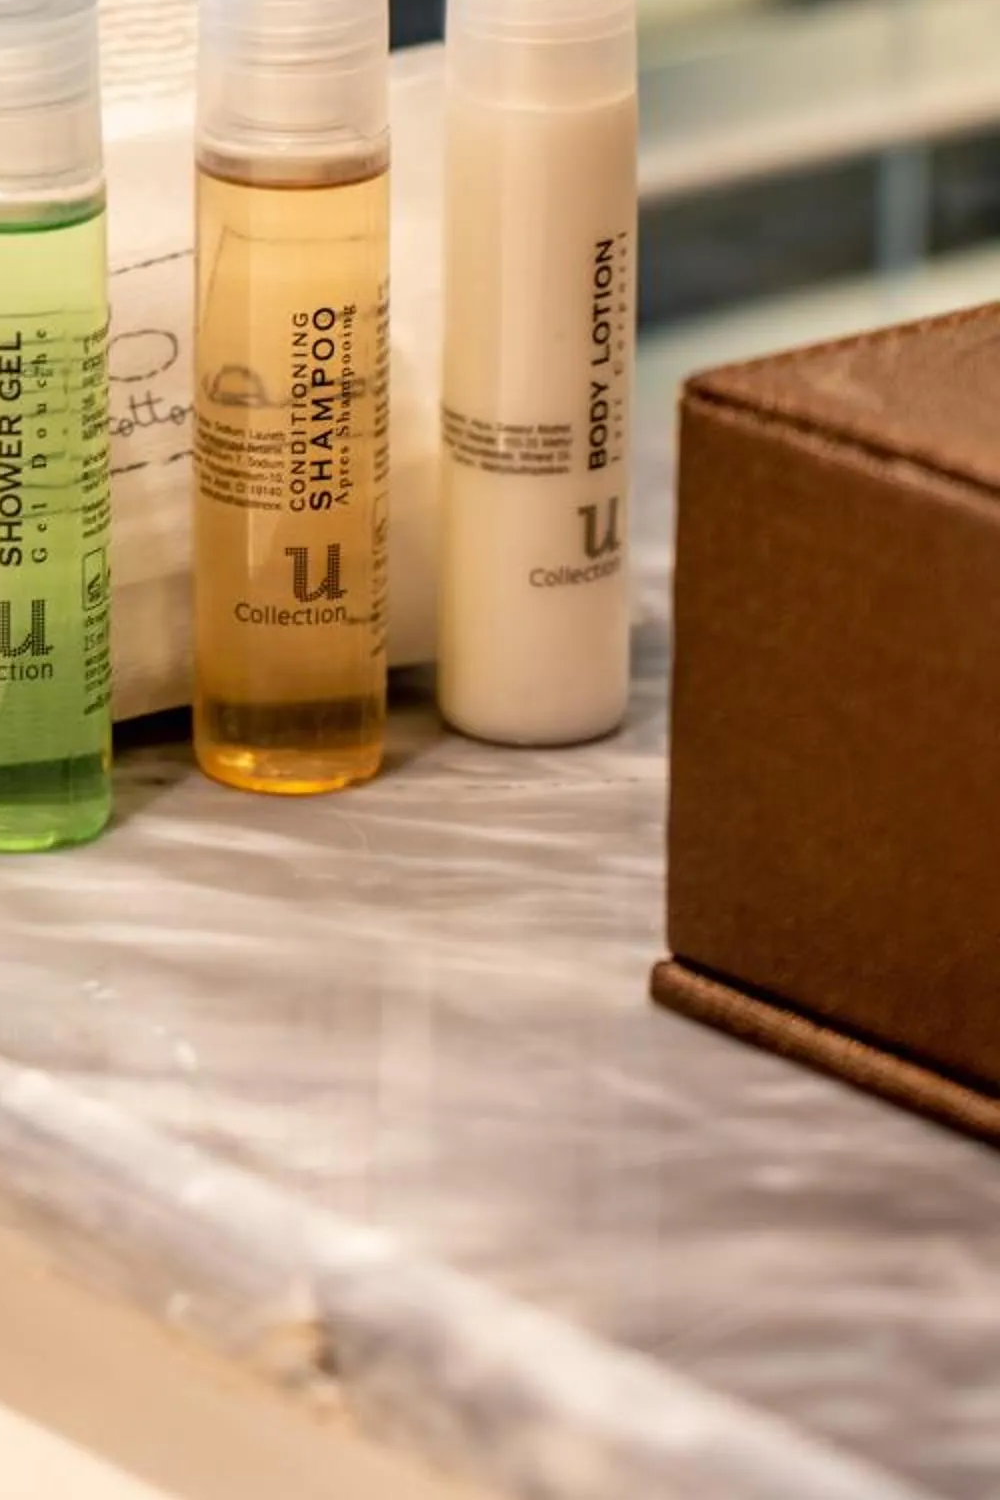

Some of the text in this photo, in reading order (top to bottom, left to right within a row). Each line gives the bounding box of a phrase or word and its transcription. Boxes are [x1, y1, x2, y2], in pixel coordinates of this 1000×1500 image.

[31, 329, 48, 563] Gel Douche
[289, 311, 309, 513] CONDITIONING
[309, 307, 336, 511] SHAMPOO
[336, 304, 357, 438] Shampooing
[588, 239, 614, 471] BODY LOTION
[234, 602, 346, 626] Collection
